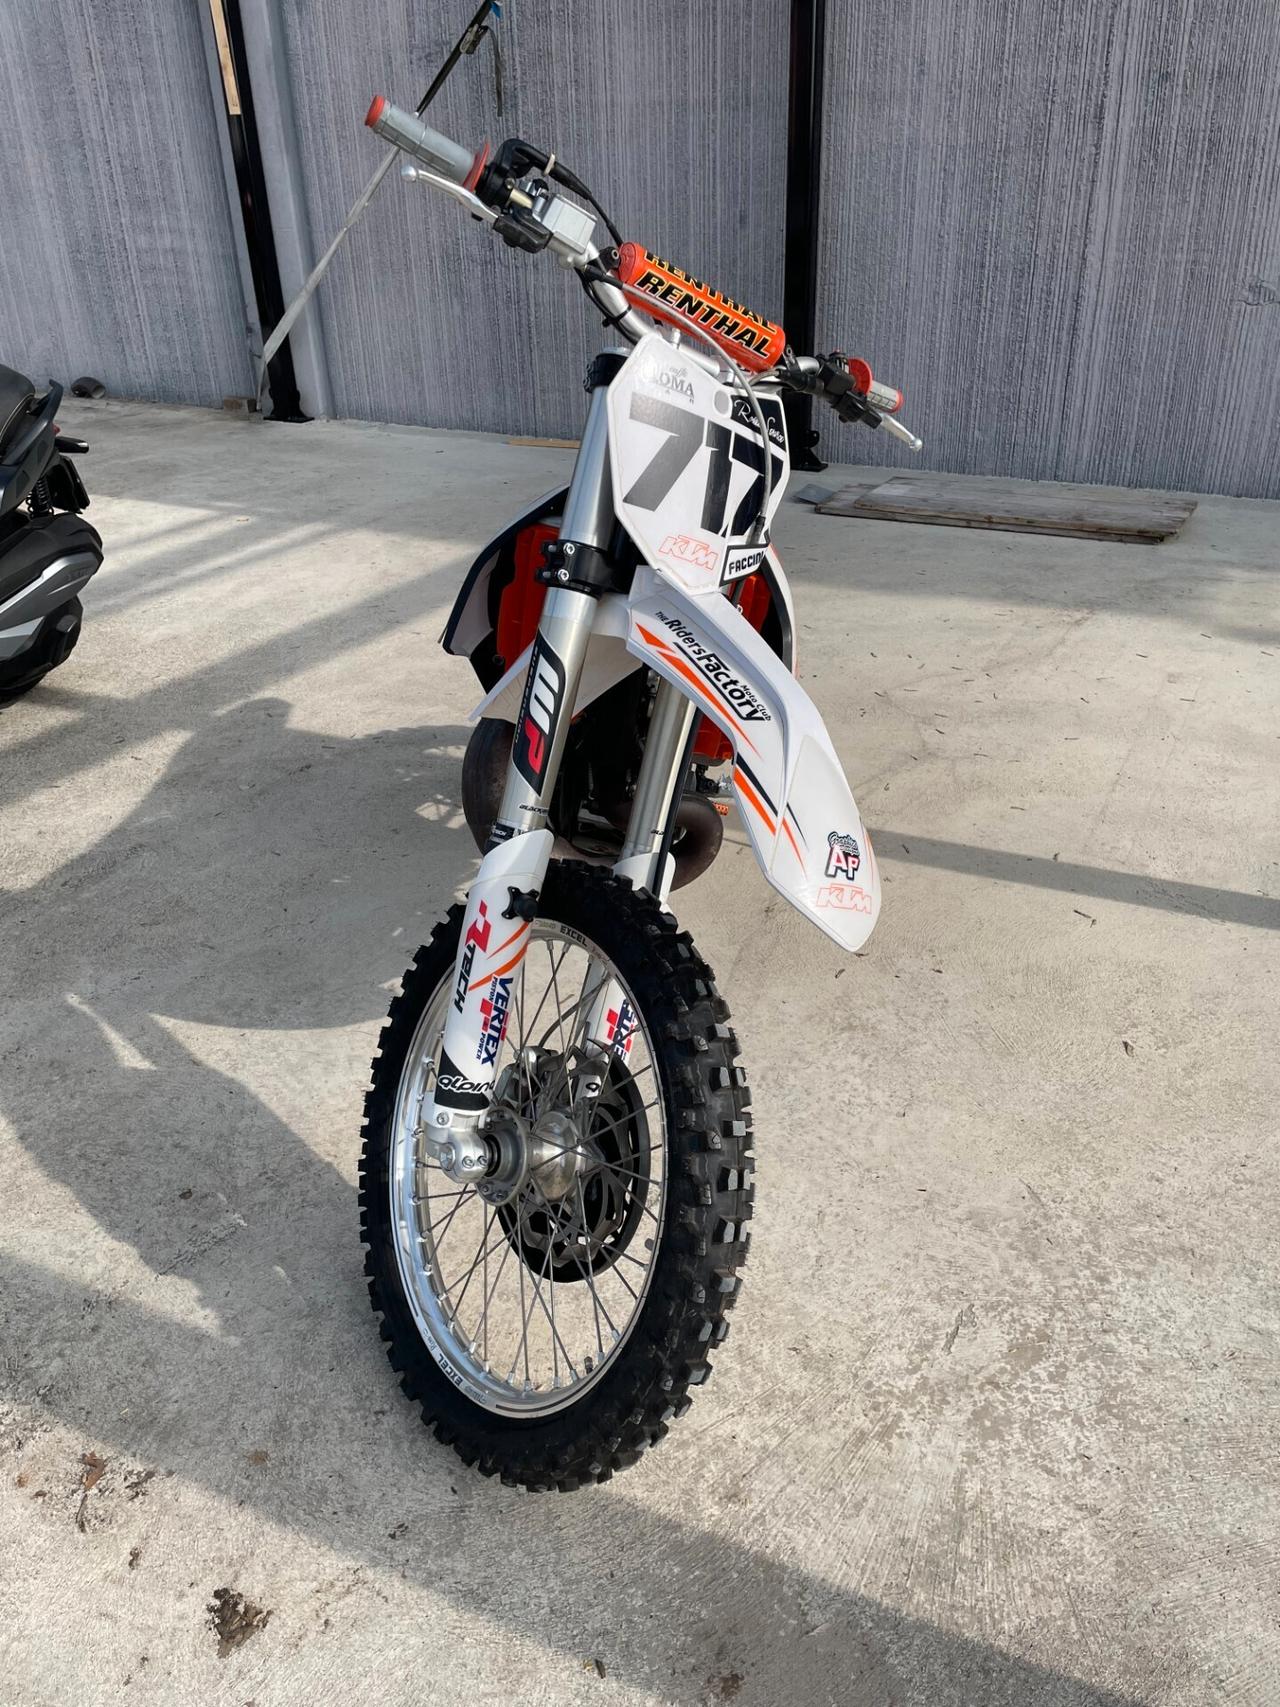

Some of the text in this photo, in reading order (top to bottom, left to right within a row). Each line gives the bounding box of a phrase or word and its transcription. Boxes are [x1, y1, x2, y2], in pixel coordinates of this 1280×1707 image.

[634, 269, 770, 359] RENTHAL
[623, 391, 784, 538] 717
[659, 535, 719, 571] KTM
[655, 611, 669, 622] THE
[740, 684, 758, 703] Moto
[824, 845, 861, 881] AP
[816, 883, 872, 914] KTM
[559, 925, 588, 947] EXCEL
[489, 976, 499, 1003] PISTON
[481, 976, 514, 1068] VERTEX
[475, 1032, 486, 1060] POWER
[437, 1353, 463, 1387] EXCEL
